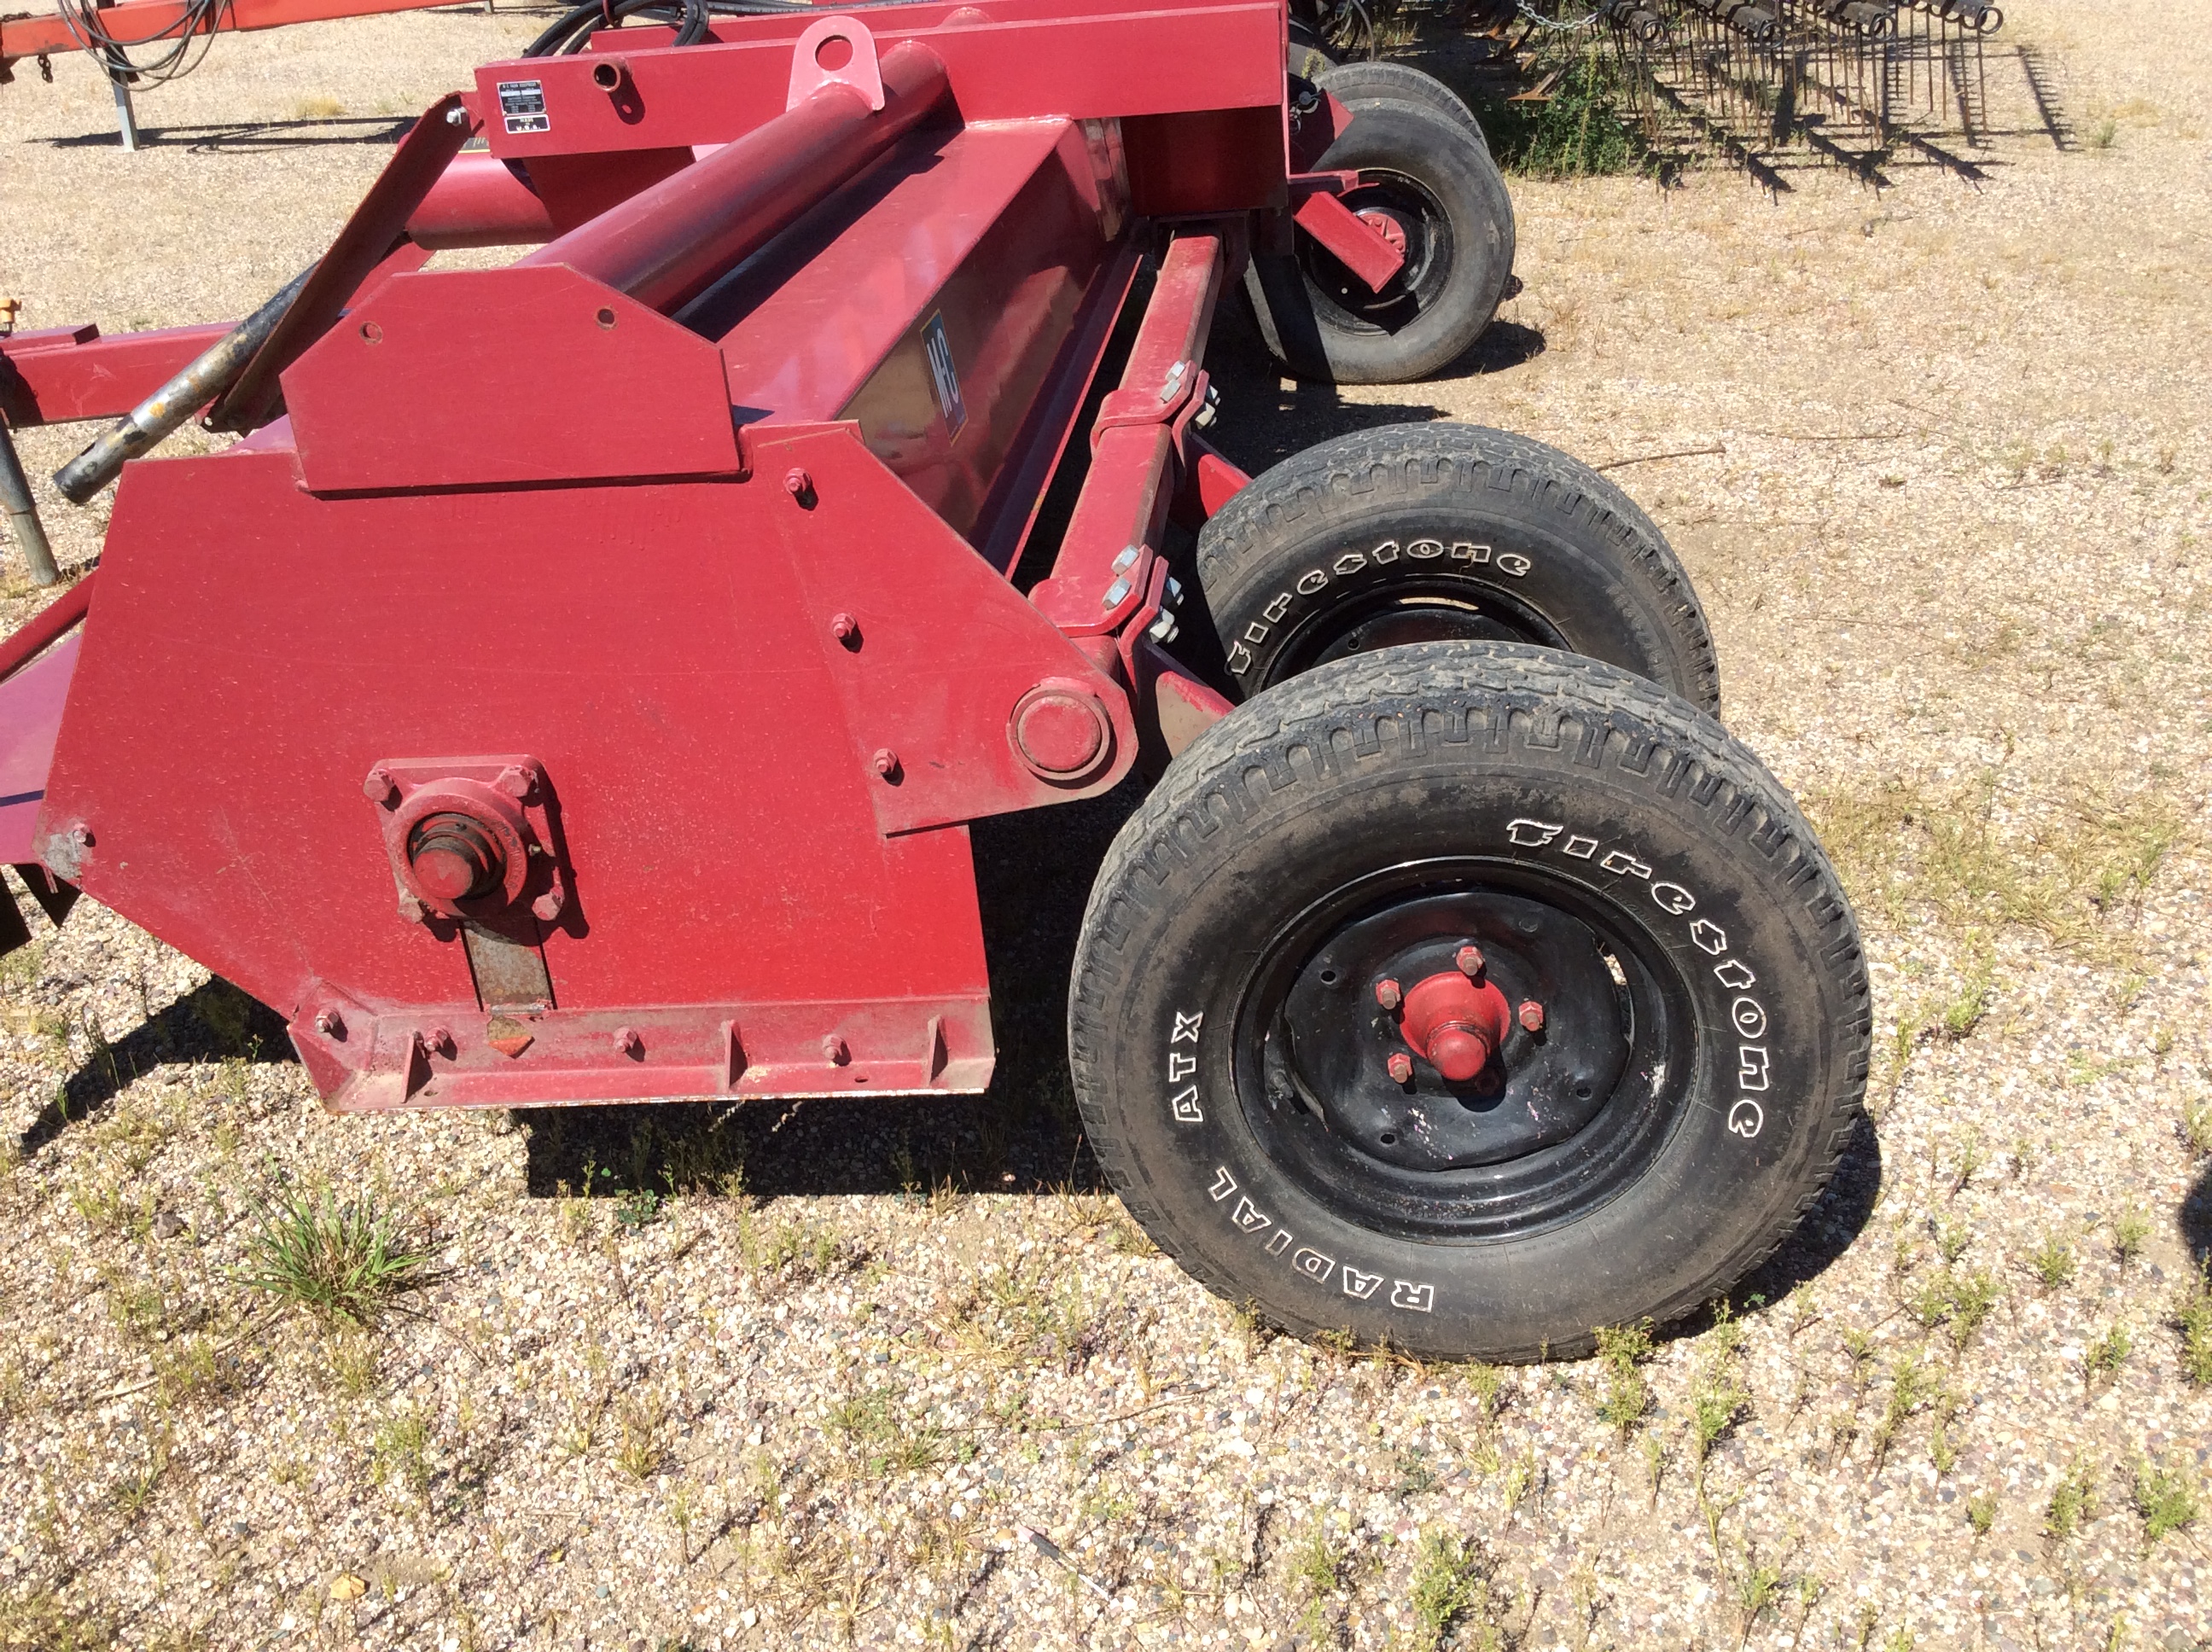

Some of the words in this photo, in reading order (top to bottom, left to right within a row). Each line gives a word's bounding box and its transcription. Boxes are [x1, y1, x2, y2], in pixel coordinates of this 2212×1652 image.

[1506, 818, 1770, 1138] Firestone
[1168, 1011, 1204, 1122] ATX
[1208, 1166, 1435, 1313] RADIAL
